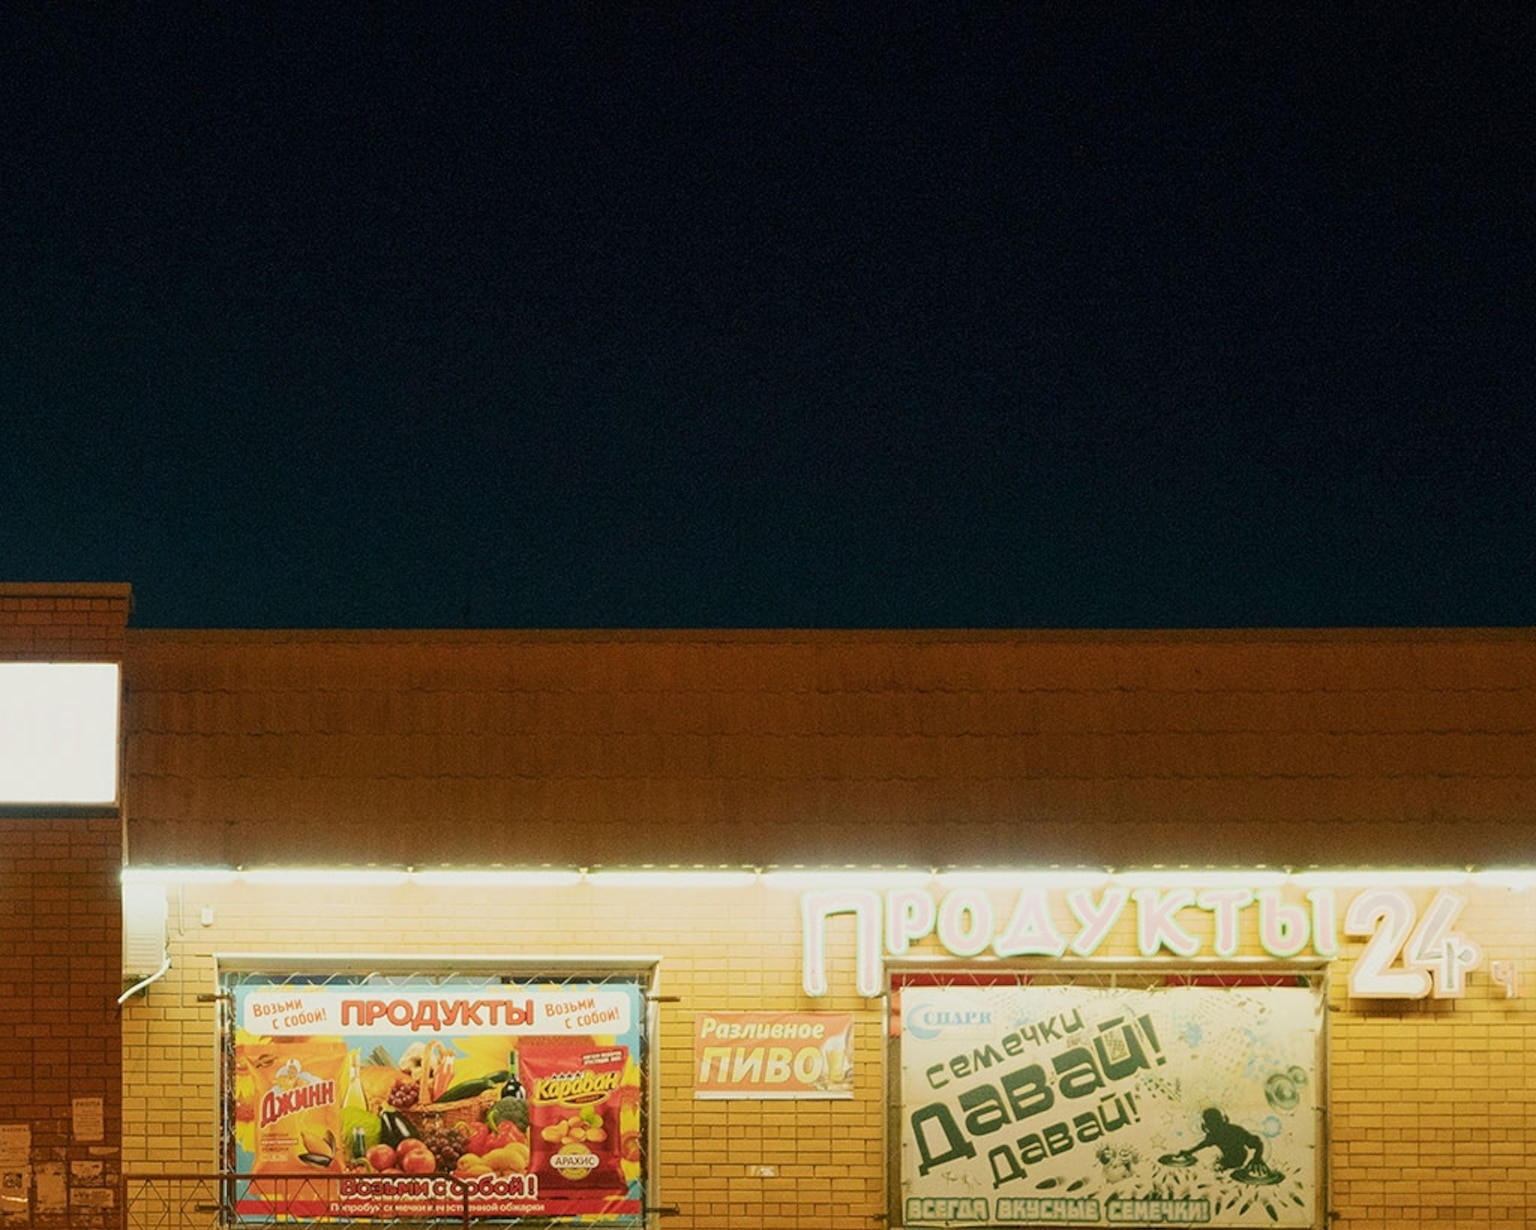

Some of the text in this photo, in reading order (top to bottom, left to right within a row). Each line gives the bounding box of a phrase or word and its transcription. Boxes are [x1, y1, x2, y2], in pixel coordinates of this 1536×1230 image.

[1344, 886, 1483, 1000] 24
[252, 998, 304, 1018] Возьми
[284, 1007, 328, 1028] собой!
[340, 999, 535, 1032] ПРОДУКТЫ
[544, 997, 596, 1018] Возьми
[576, 1006, 621, 1028] собой!
[699, 1017, 826, 1040] Разливное
[925, 1007, 1086, 1090] семечки
[698, 1046, 824, 1084] ПИВО
[534, 1070, 620, 1101] Караван
[554, 1156, 597, 1167] АРАХИС
